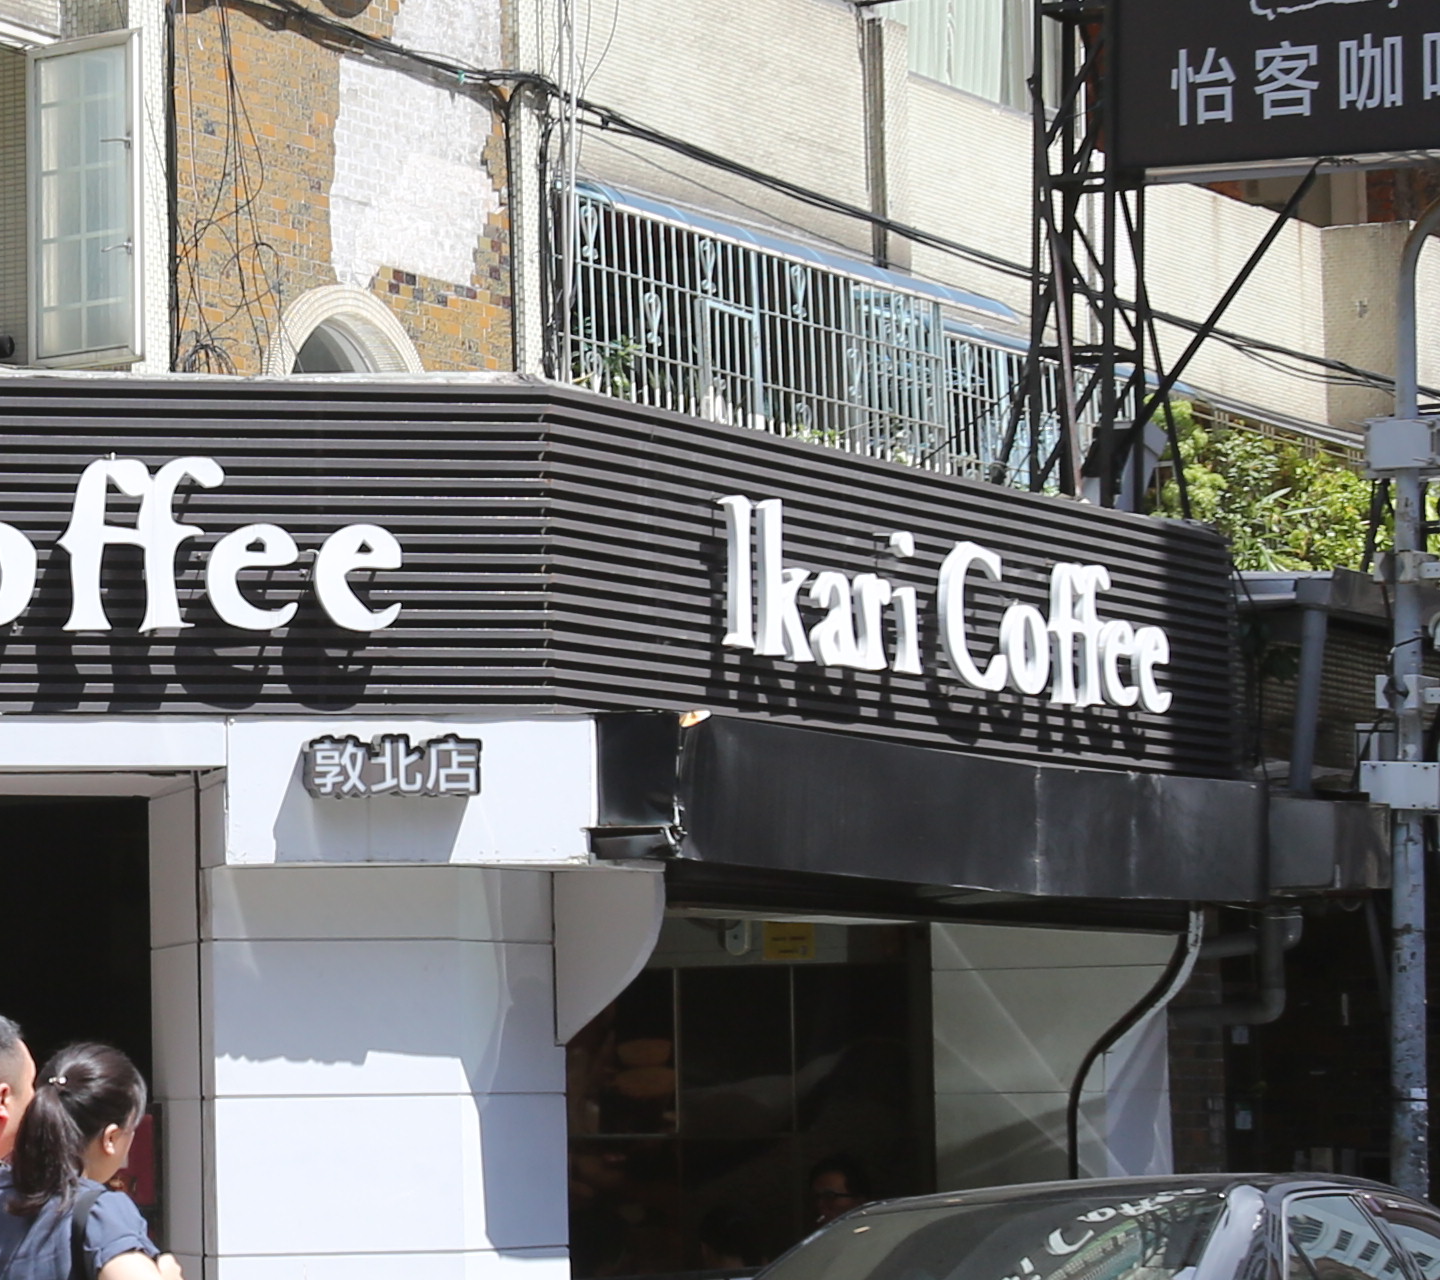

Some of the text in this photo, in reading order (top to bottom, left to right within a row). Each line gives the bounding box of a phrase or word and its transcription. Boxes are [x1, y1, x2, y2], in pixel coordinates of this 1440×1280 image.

[717, 495, 1173, 714] Ikari Coffee
[313, 738, 478, 793] 敦北店
